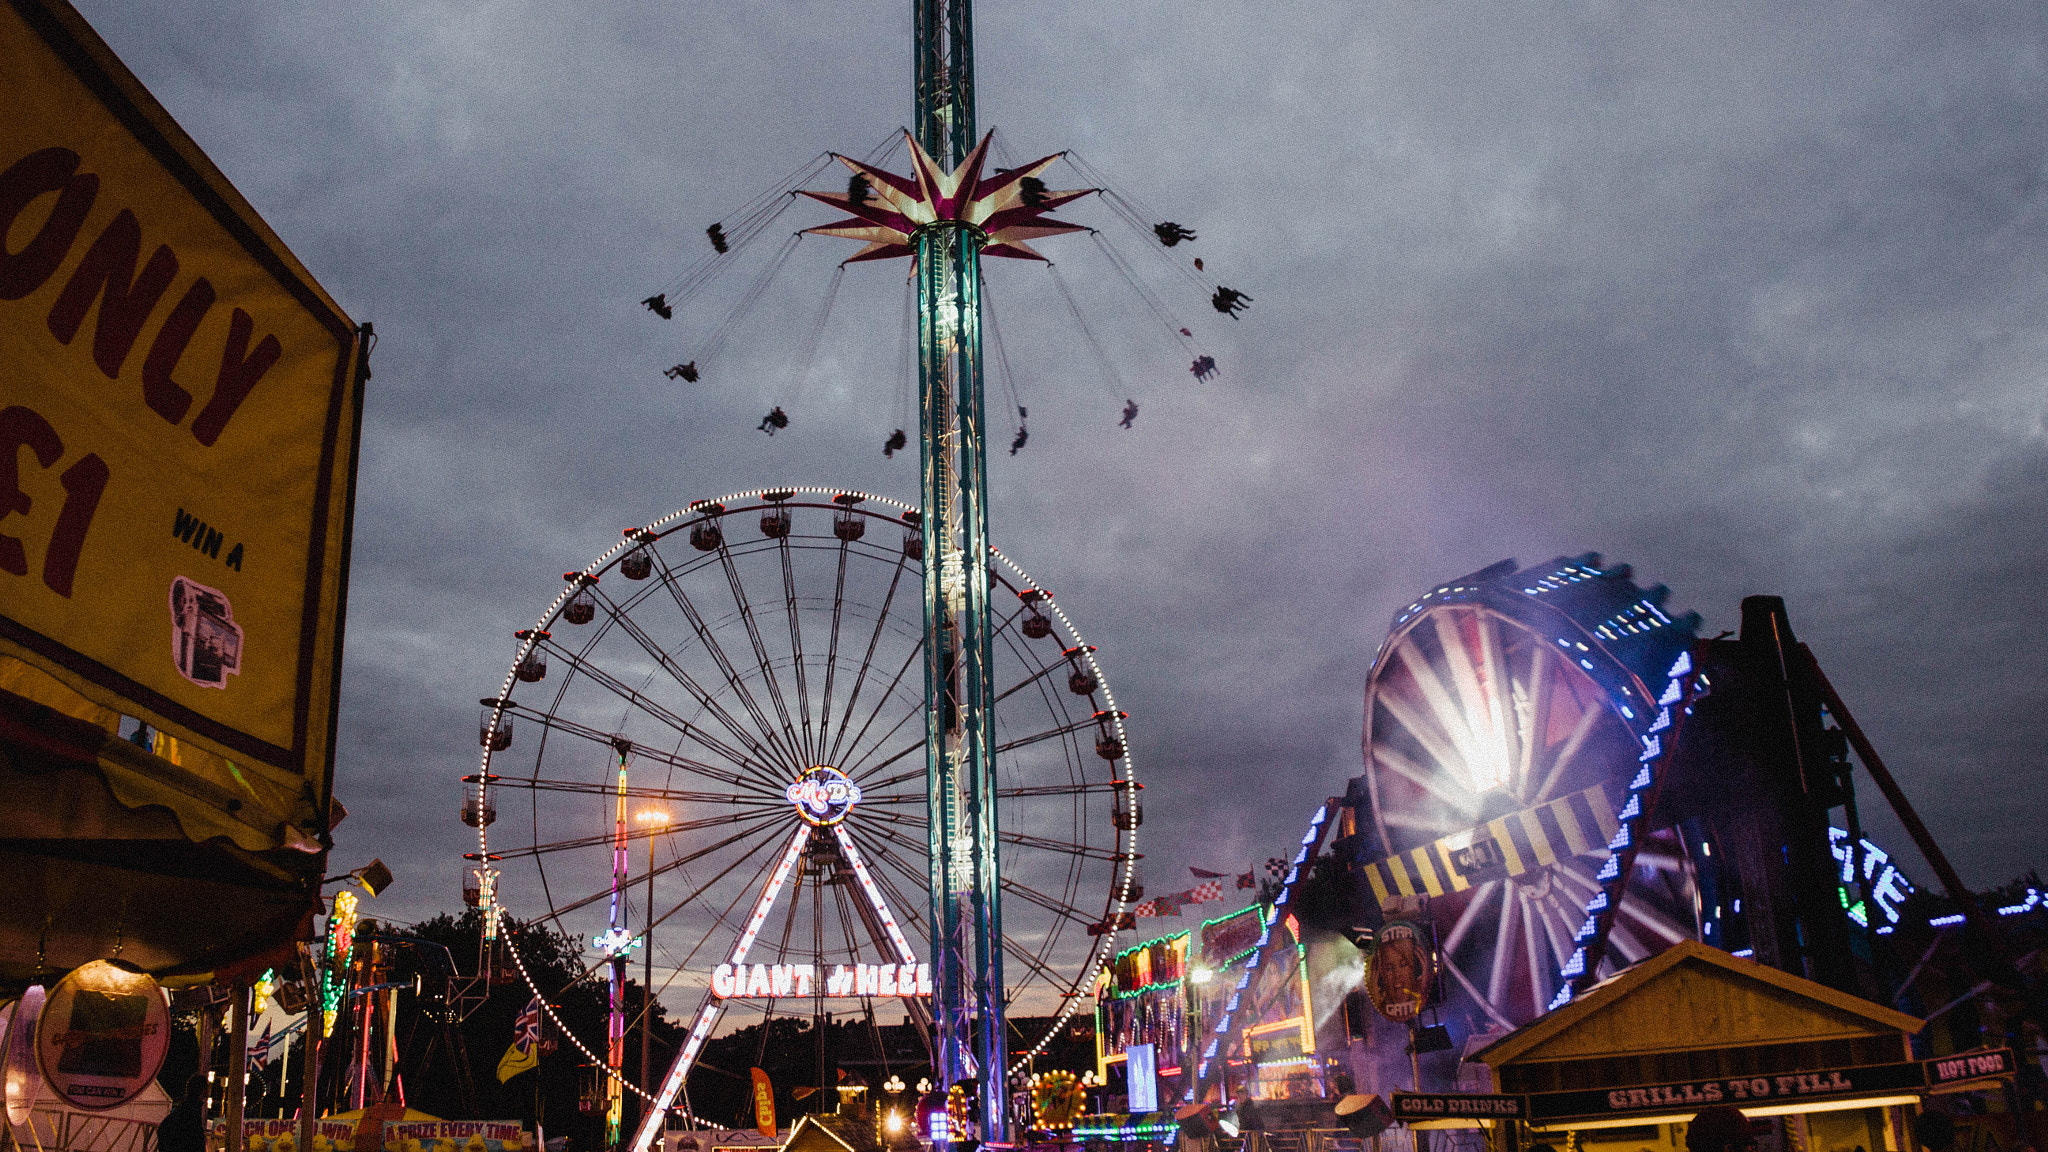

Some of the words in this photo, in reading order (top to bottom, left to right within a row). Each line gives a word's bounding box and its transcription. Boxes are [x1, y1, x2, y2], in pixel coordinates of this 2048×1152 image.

[0, 147, 282, 447] ONLY
[0, 405, 110, 600] £1
[172, 508, 224, 560] WIN
[226, 542, 244, 572] A
[1382, 925, 1413, 943] STAR
[711, 963, 815, 1000] GIANT
[826, 962, 933, 998] WHEEL
[1937, 1059, 1967, 1080] HOT
[1967, 1053, 2004, 1075] FOOD
[1608, 1082, 1723, 1109] GRILLS
[1728, 1078, 1770, 1099] TO
[1775, 1071, 1852, 1096] FILL
[1401, 1098, 1445, 1113] COLD
[1447, 1099, 1519, 1115] DRINKS
[268, 1119, 297, 1137] ONE
[322, 1121, 353, 1141] WIN
[385, 1125, 396, 1143] A
[398, 1123, 437, 1140] PRIZE
[440, 1121, 484, 1138] EVERY
[487, 1123, 521, 1142] TIME
